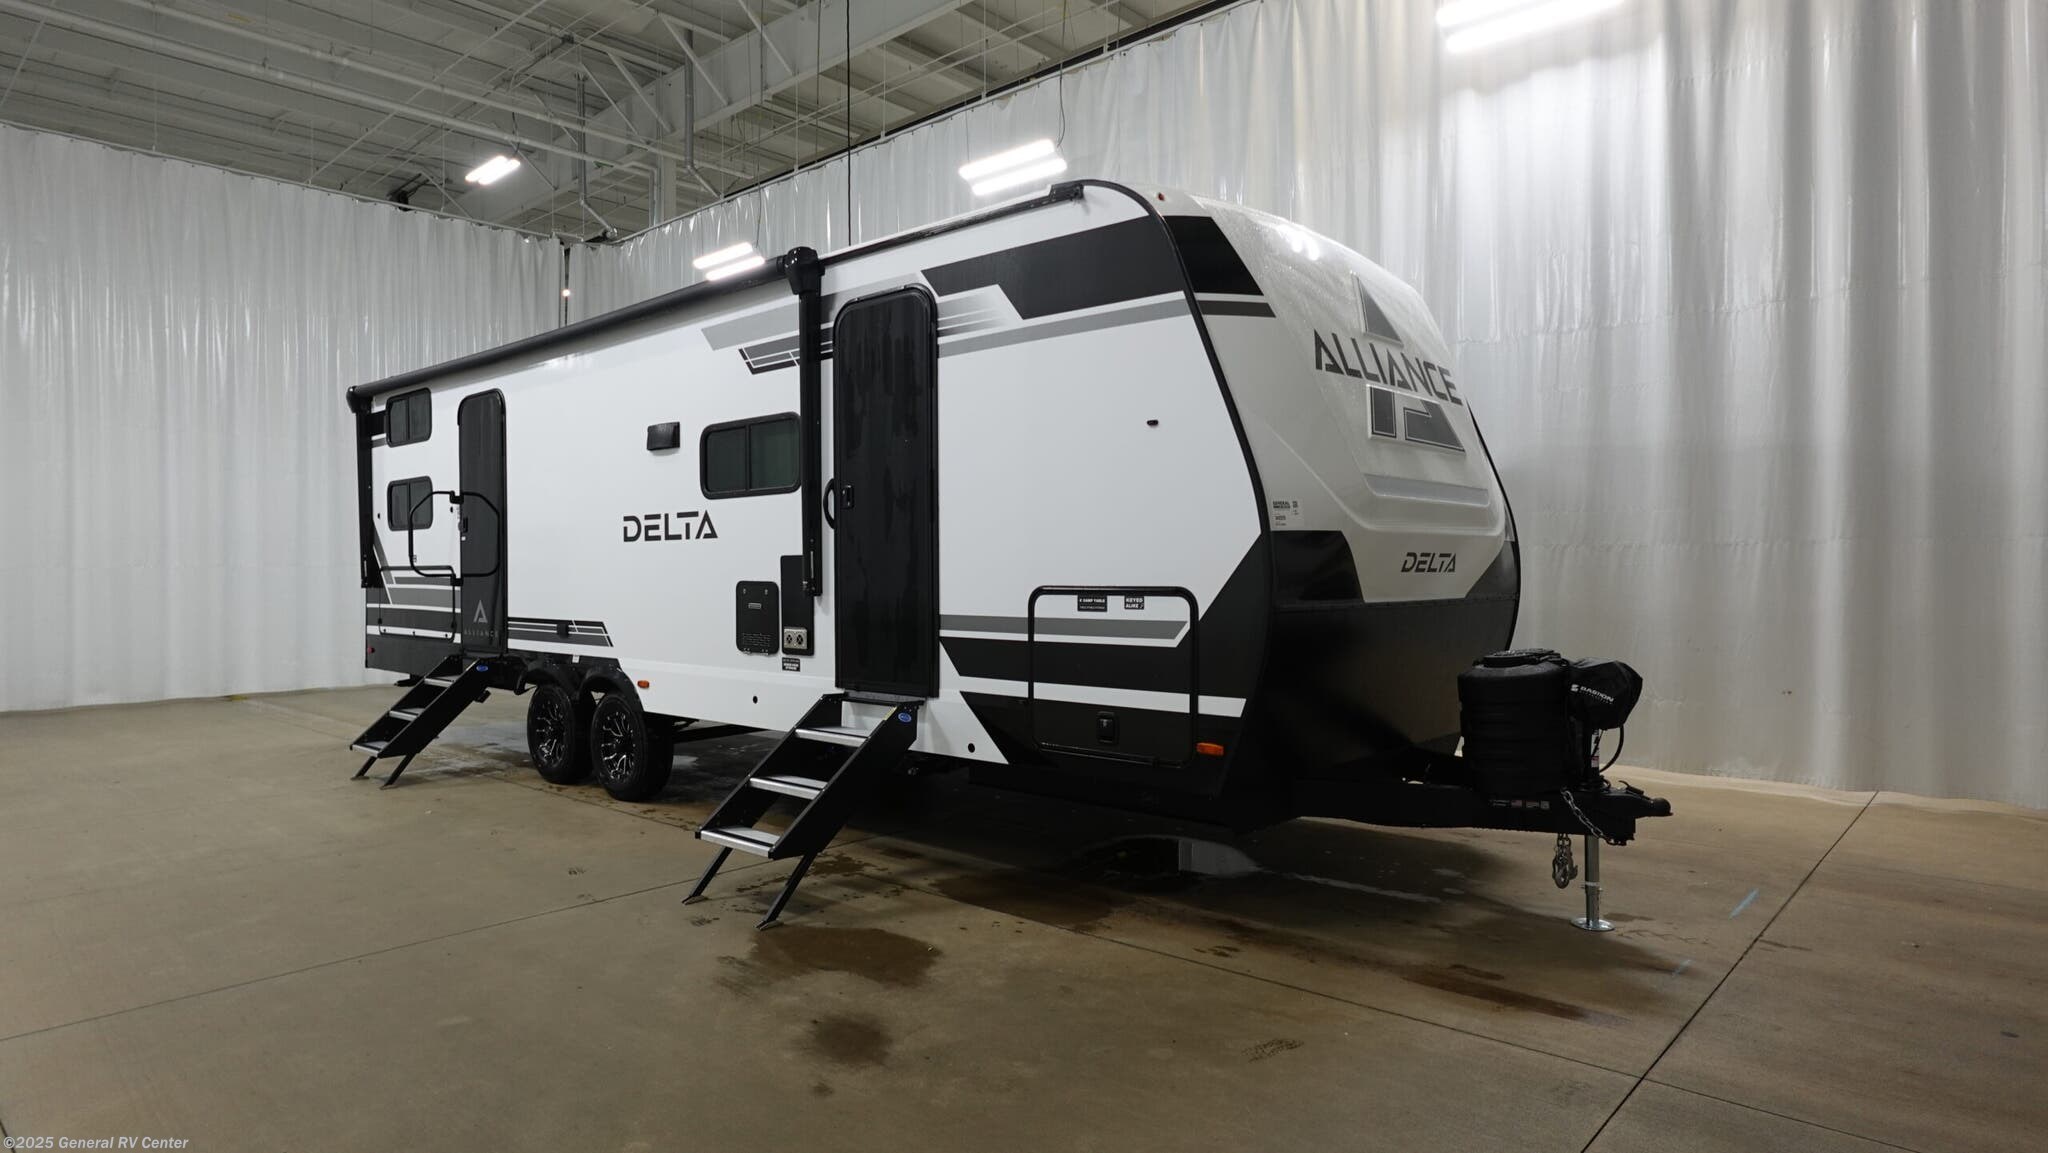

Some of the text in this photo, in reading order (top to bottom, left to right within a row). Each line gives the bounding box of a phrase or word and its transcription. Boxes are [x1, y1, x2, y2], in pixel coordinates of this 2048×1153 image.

[1313, 329, 1463, 406] ALLIANCE
[623, 510, 718, 543] DELTA
[1400, 552, 1457, 573] DELTA
